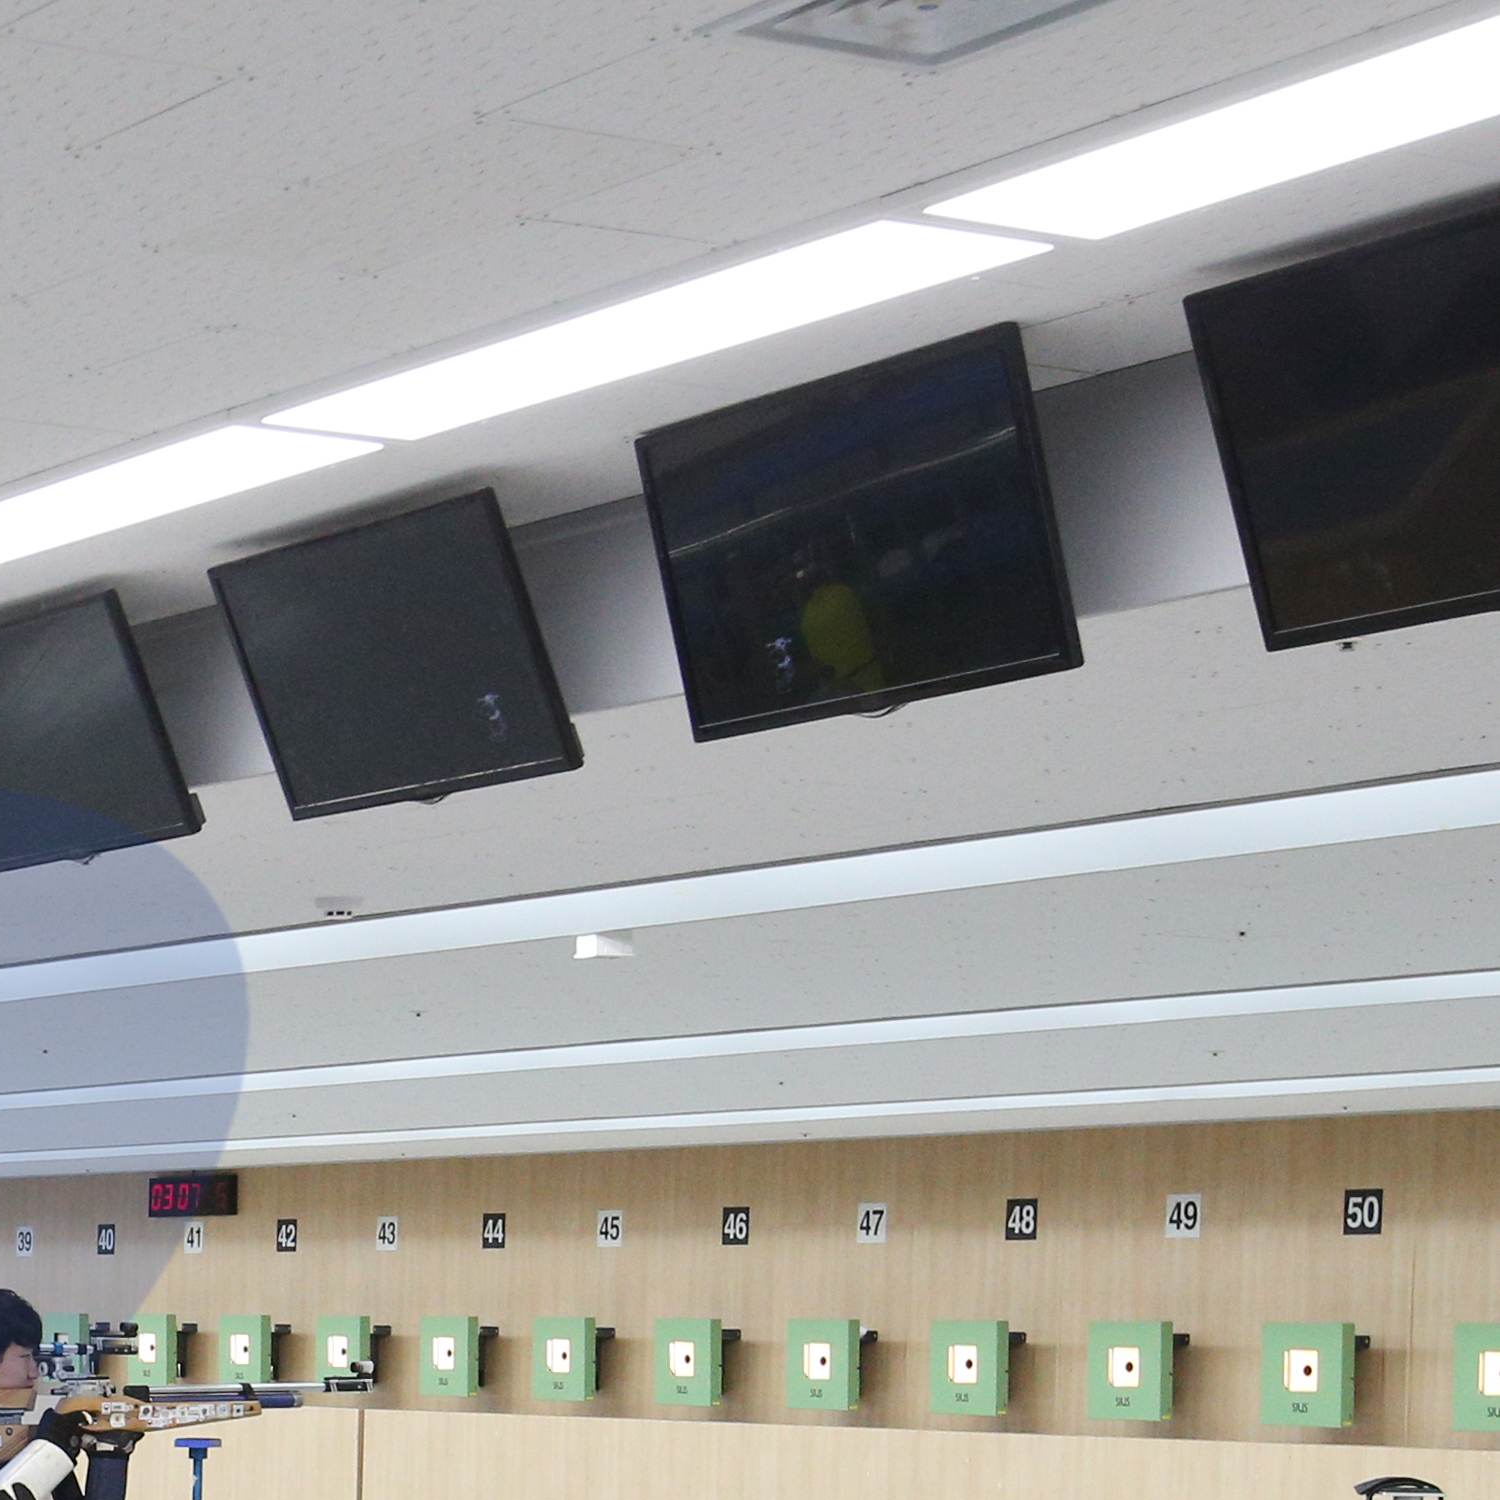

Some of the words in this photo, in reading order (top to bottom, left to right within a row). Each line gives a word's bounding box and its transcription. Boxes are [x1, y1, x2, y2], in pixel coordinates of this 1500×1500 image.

[860, 1210, 884, 1236] 47
[1008, 1205, 1035, 1235] 48
[1169, 1200, 1198, 1230] 49
[1346, 1195, 1380, 1229] 50
[186, 1227, 202, 1248] 41
[278, 1224, 296, 1248] 42
[378, 1221, 396, 1245] 43
[484, 1218, 504, 1244] 44
[599, 1216, 620, 1241] 45
[724, 1212, 747, 1240] 46
[18, 1231, 32, 1252] 39
[98, 1228, 114, 1250] 40
